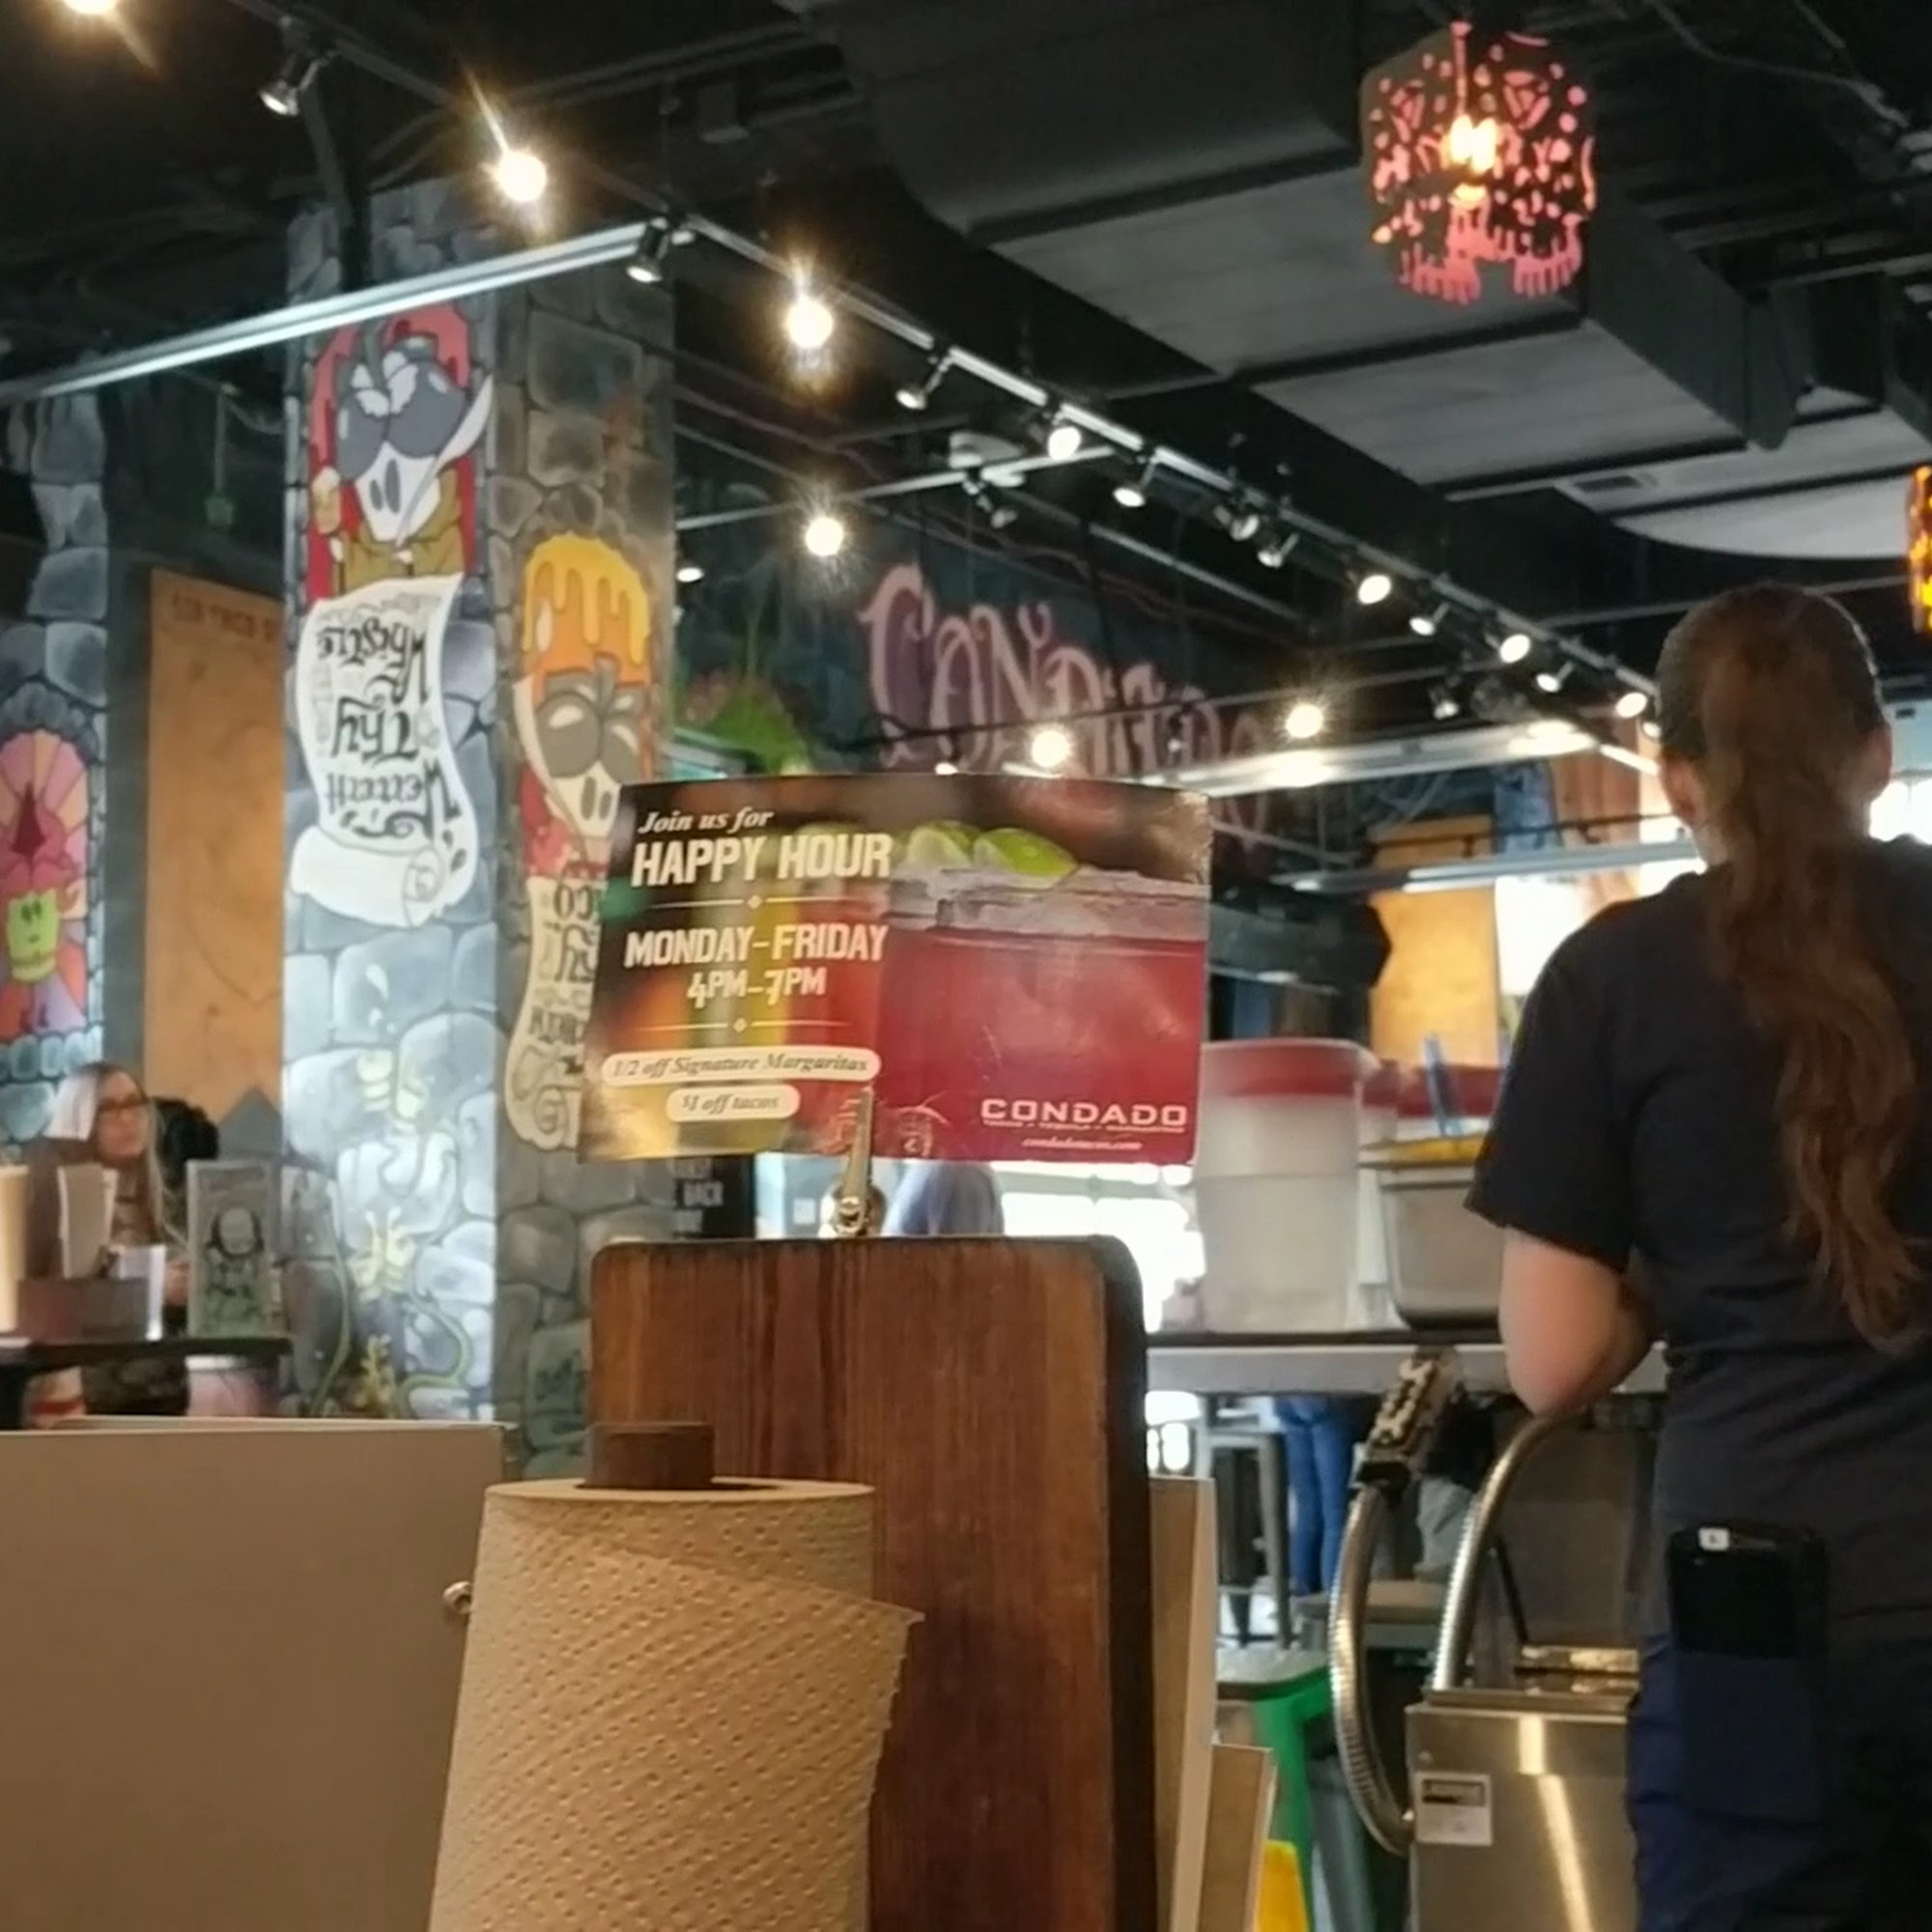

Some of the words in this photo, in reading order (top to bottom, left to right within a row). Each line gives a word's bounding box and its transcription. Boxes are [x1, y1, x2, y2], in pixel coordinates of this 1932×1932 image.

[638, 810, 693, 834] Join
[697, 812, 728, 831] us
[728, 807, 774, 835] for
[631, 836, 768, 887] HAPPY
[777, 833, 894, 879] HOUR
[613, 1060, 639, 1077] 1/2
[642, 1057, 669, 1077] off
[670, 1055, 759, 1077] Signature
[765, 1052, 868, 1073] Margaritas
[701, 1093, 730, 1115] off
[731, 1095, 781, 1111] tacos
[980, 1098, 1188, 1126] CONDADO
